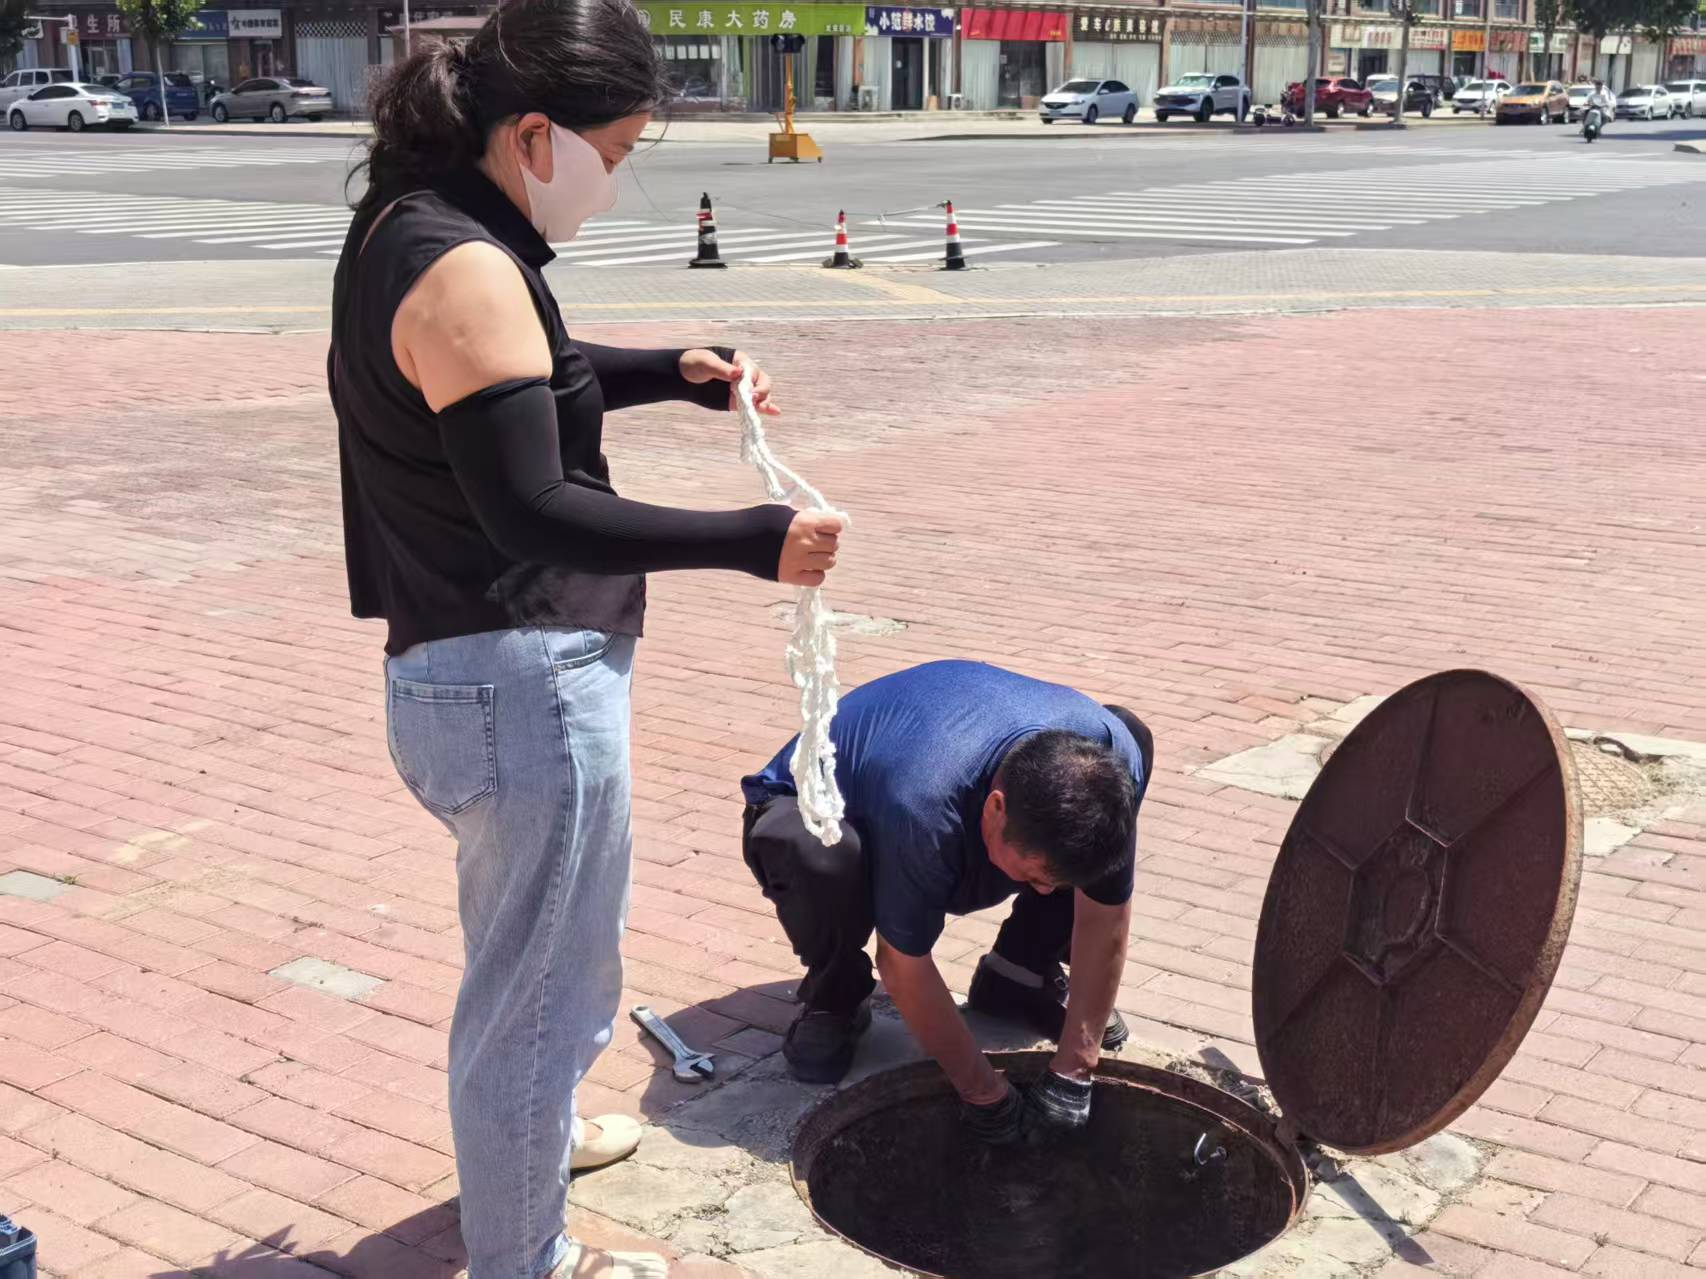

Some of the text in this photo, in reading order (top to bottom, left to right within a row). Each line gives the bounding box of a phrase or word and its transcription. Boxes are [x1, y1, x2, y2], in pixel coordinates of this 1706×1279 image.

[69, 14, 120, 33] 生所
[669, 9, 797, 29] 民康大药房
